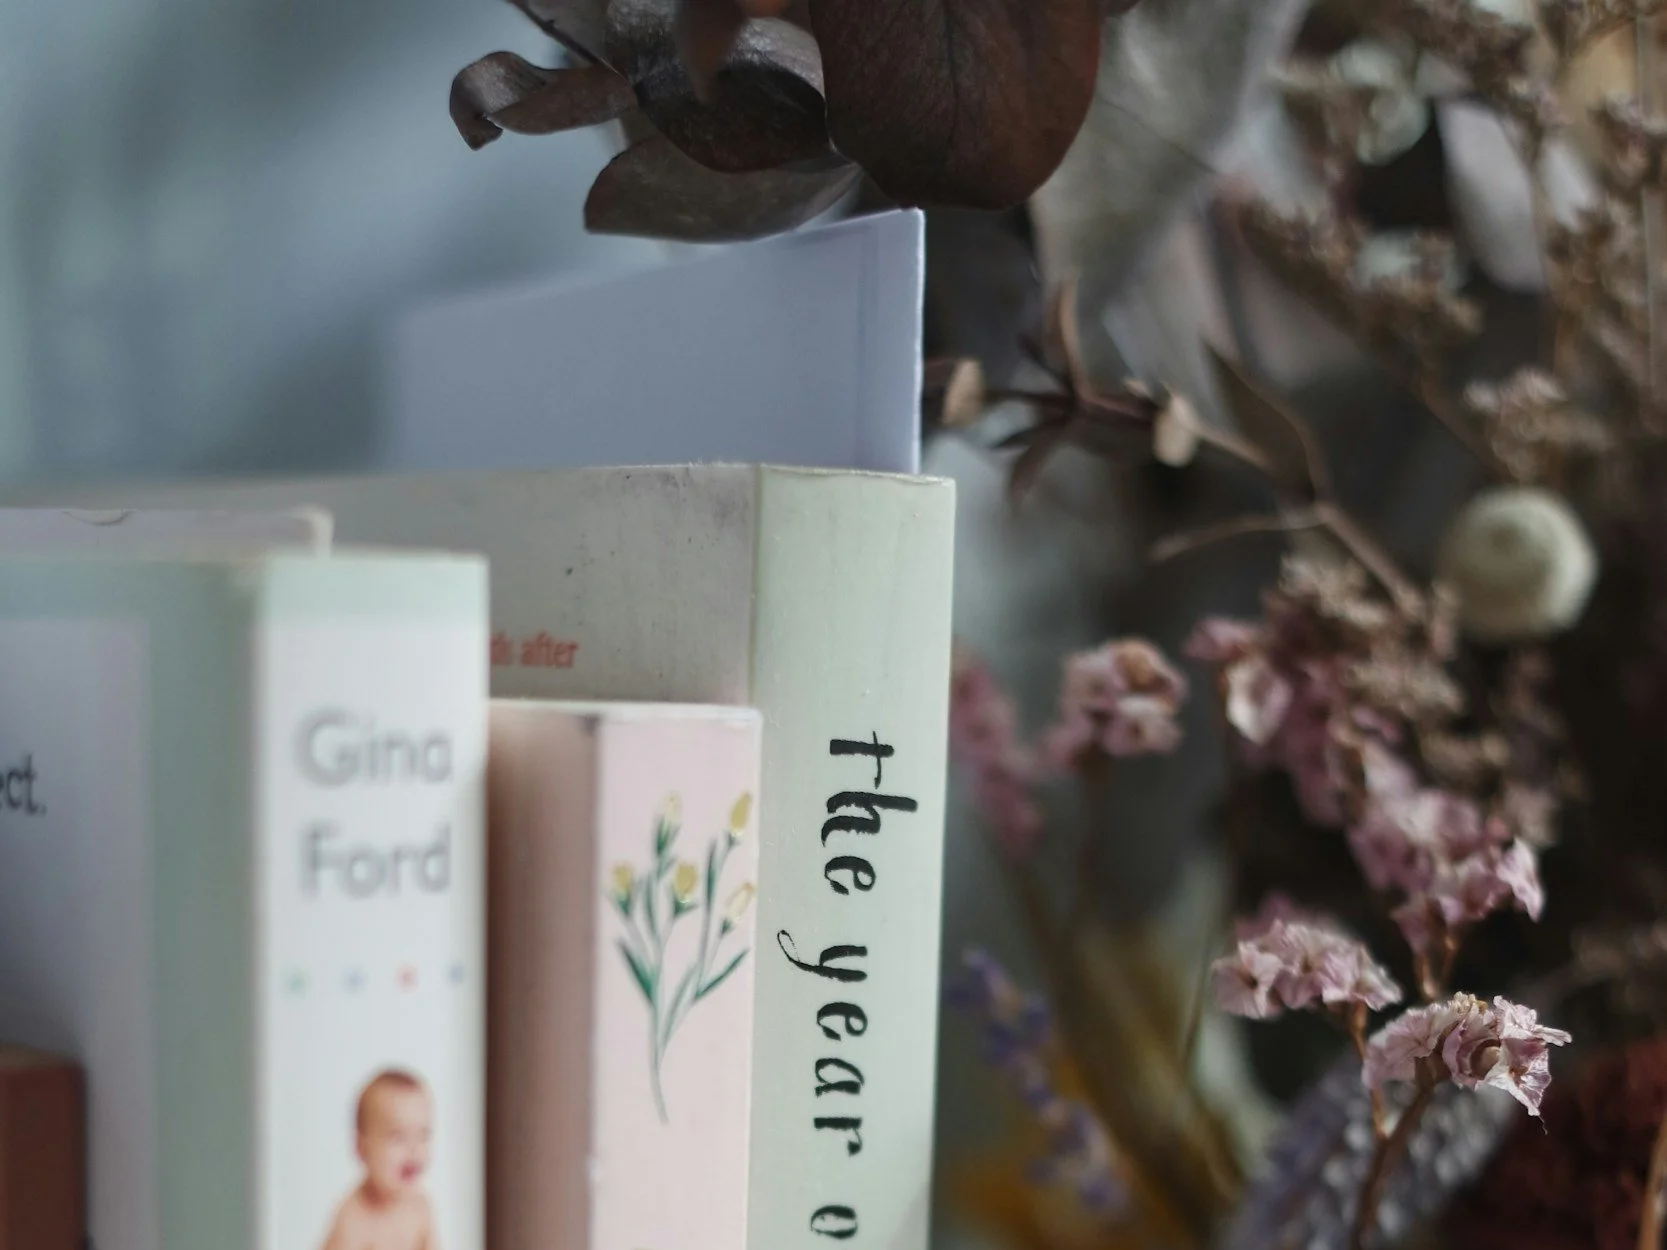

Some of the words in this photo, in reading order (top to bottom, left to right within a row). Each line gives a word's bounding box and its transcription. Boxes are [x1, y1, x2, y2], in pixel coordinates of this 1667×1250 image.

[296, 706, 455, 789] Gina
[301, 820, 454, 900] Ford
[819, 730, 919, 897] the
[776, 929, 870, 1159] year
